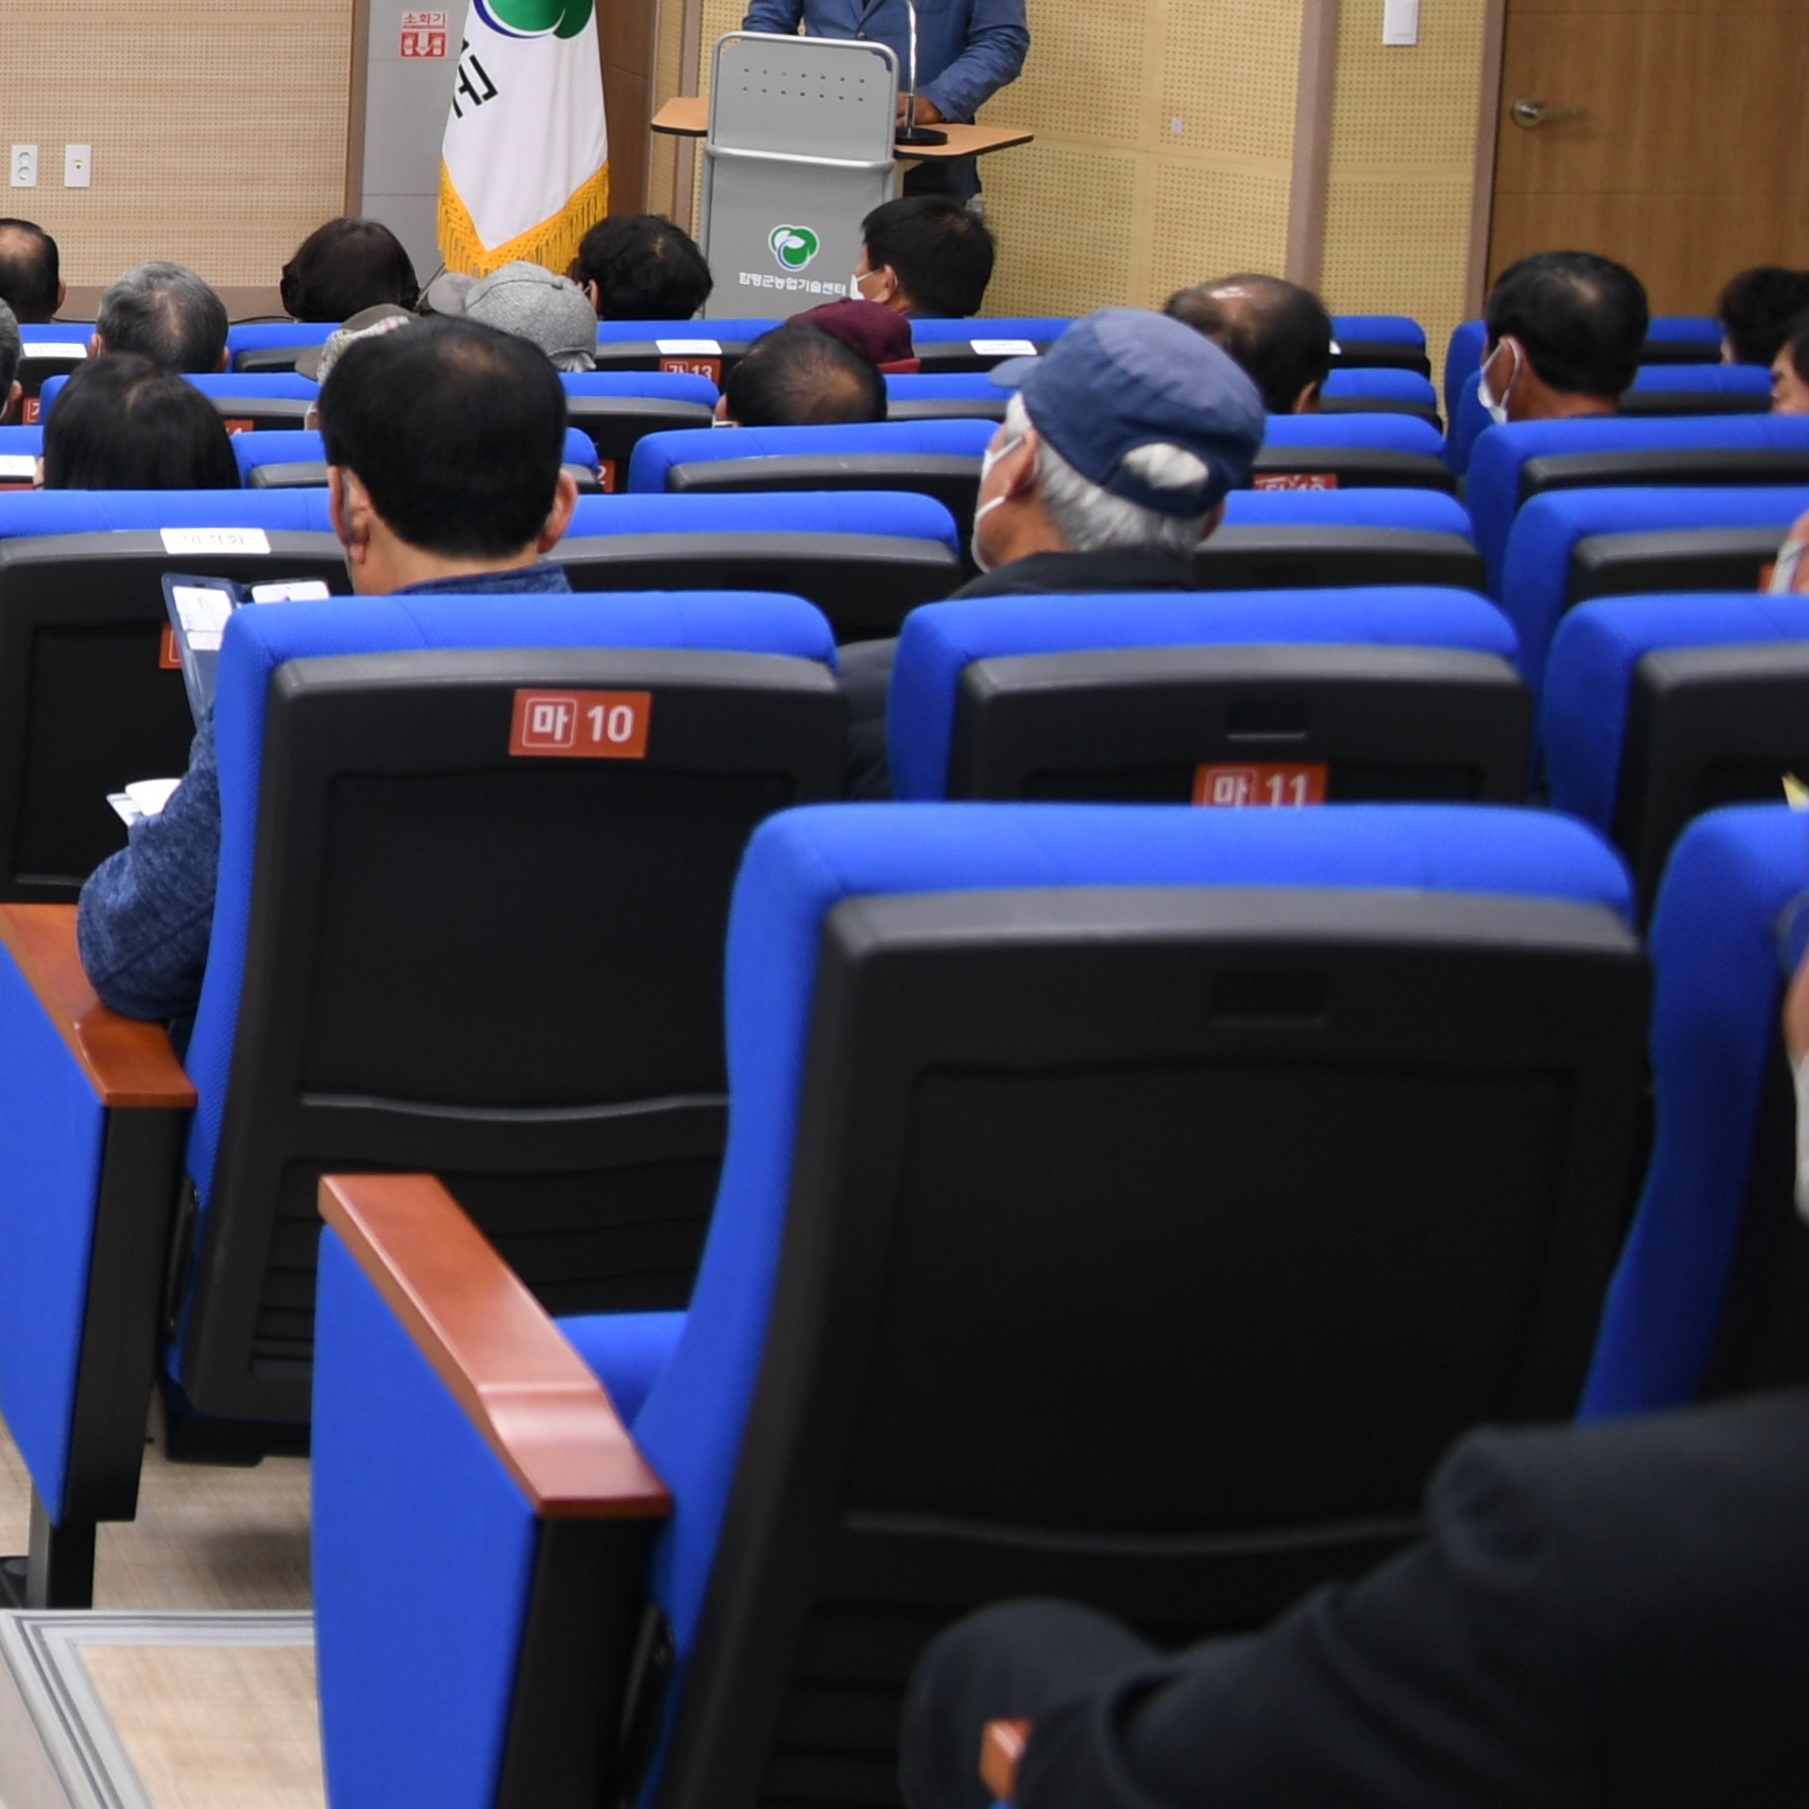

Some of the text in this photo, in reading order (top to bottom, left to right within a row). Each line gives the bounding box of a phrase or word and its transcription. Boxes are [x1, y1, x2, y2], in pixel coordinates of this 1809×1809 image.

[403, 13, 446, 25] 소화기
[739, 271, 847, 297] 함평군농업기술센터
[533, 704, 634, 743] 마 10
[1213, 774, 1308, 810] 마 11
